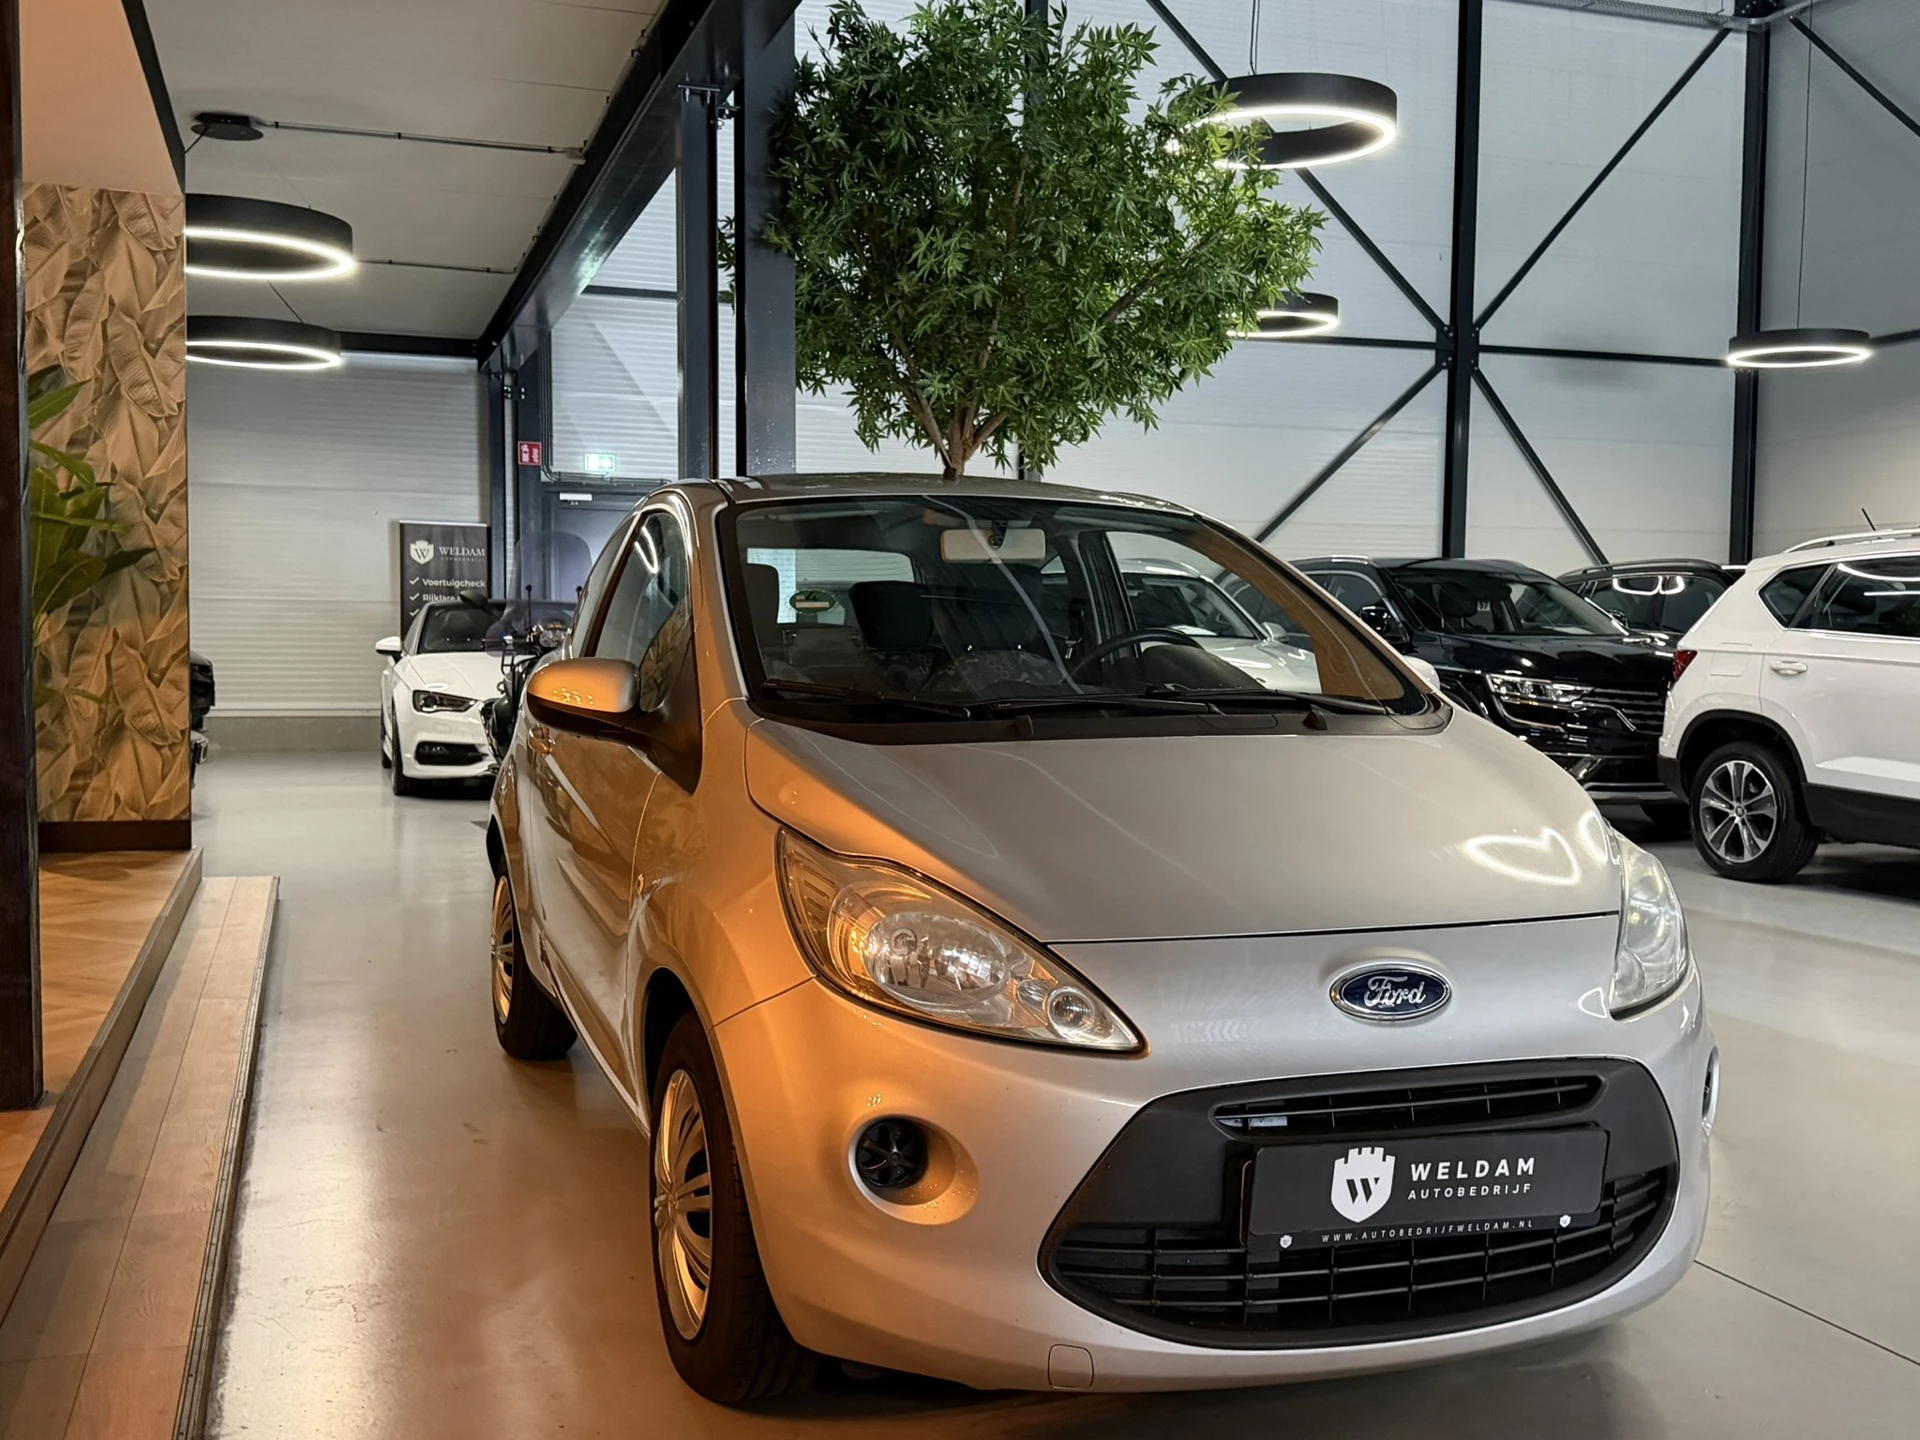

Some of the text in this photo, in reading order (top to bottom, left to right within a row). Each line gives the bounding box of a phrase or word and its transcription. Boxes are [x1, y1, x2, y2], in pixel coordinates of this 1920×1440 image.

[415, 548, 430, 559] W
[439, 546, 485, 557] WELDAM
[422, 578, 486, 588] Voertuigcheck
[1364, 976, 1426, 1007] Ford
[1411, 1157, 1535, 1181] WELDAM
[1345, 1177, 1381, 1205] W
[1407, 1183, 1531, 1200] AUTOBEDRIJF
[1321, 1220, 1532, 1242] WWW.AUTOBEDRIJFWELDAM.NL
